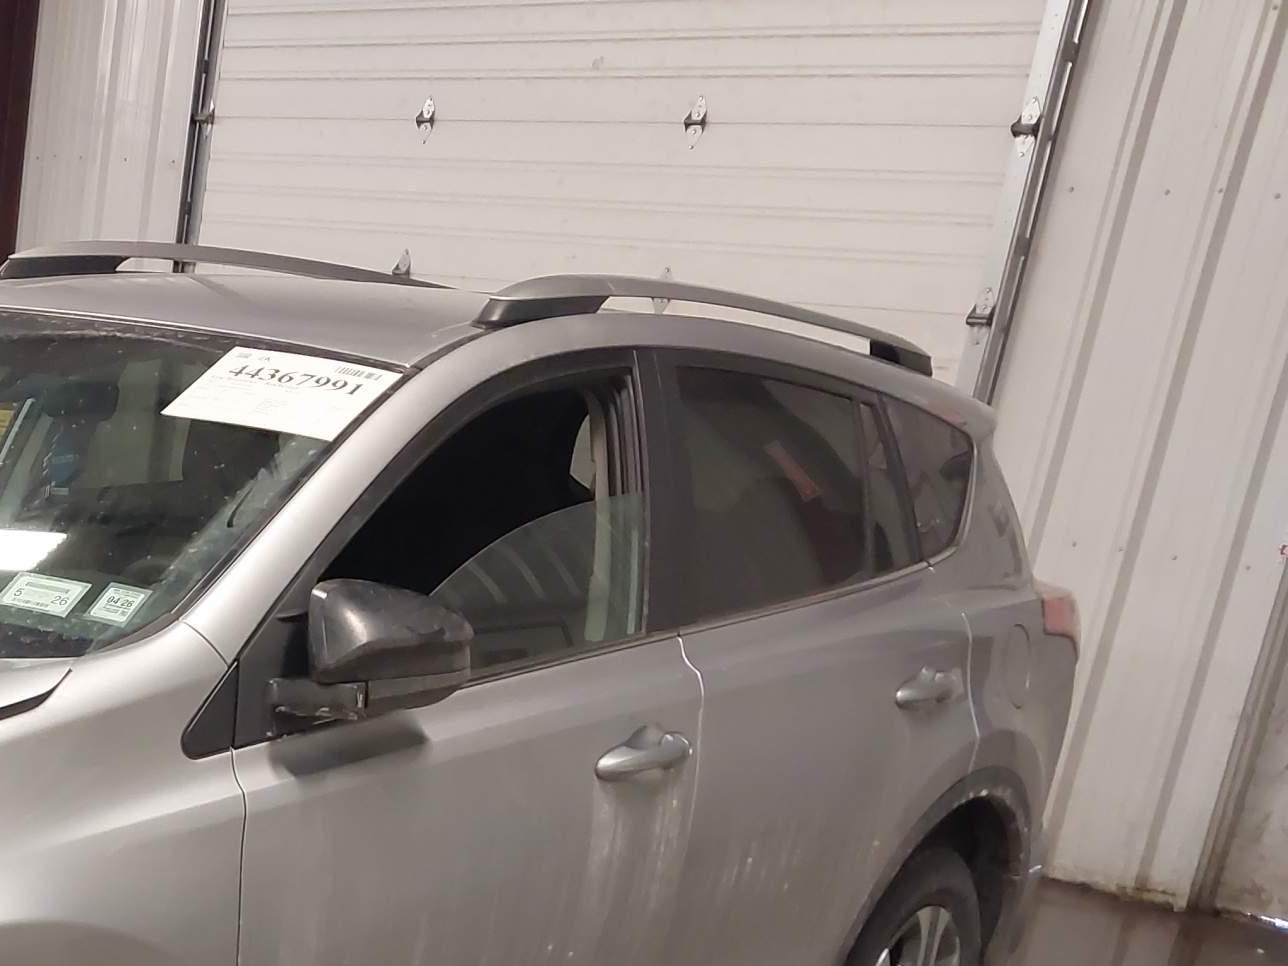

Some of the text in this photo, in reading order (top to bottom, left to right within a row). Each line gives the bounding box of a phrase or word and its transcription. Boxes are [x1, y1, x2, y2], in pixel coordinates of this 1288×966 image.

[228, 364, 364, 395] 44367991
[13, 587, 24, 597] 5
[50, 595, 70, 606] 26
[120, 599, 135, 608] 26
